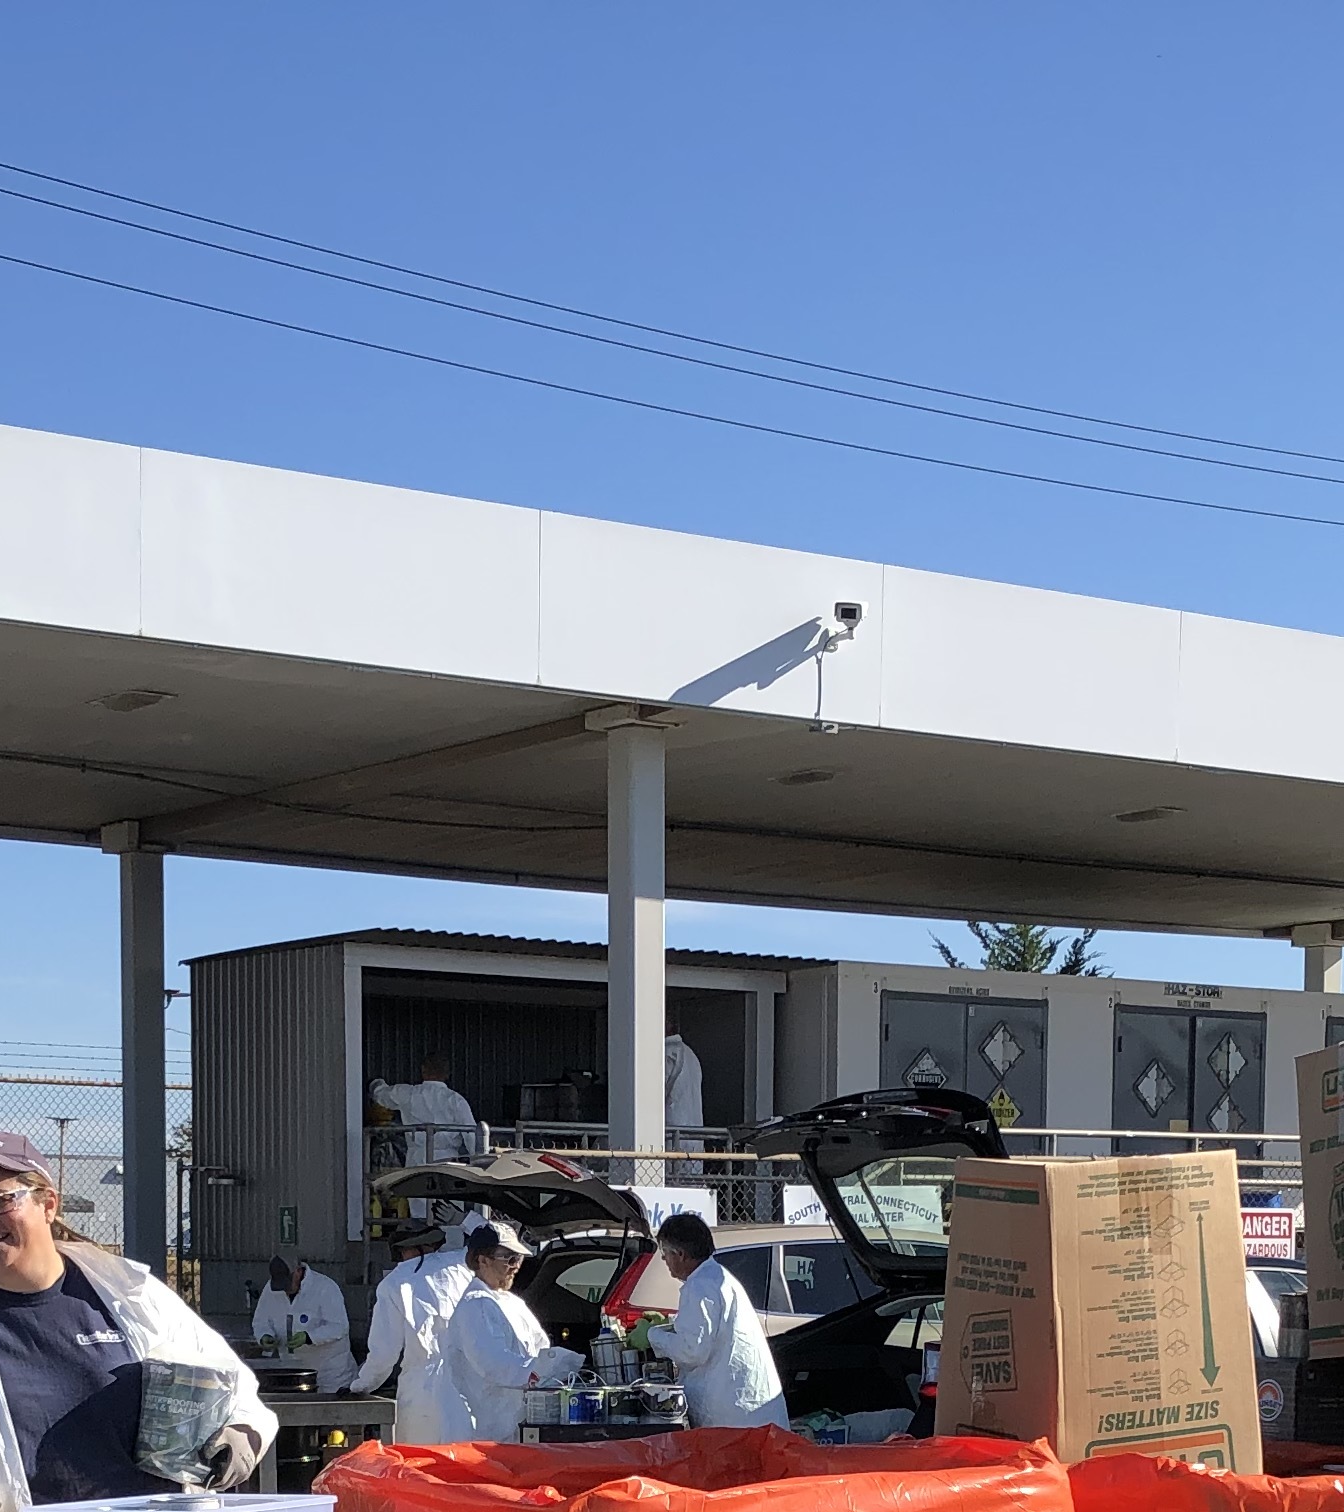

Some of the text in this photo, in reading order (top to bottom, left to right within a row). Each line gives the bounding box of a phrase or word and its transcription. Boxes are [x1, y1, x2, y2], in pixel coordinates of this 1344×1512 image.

[788, 1202, 822, 1224] SOUTH
[843, 1195, 867, 1206] TRAL
[872, 1195, 939, 1224] ONNECTICUT
[1243, 1216, 1290, 1236] ANGER
[1246, 1243, 1288, 1257] ZARDOUS
[1098, 1400, 1219, 1433] SIZE MATTERS!
